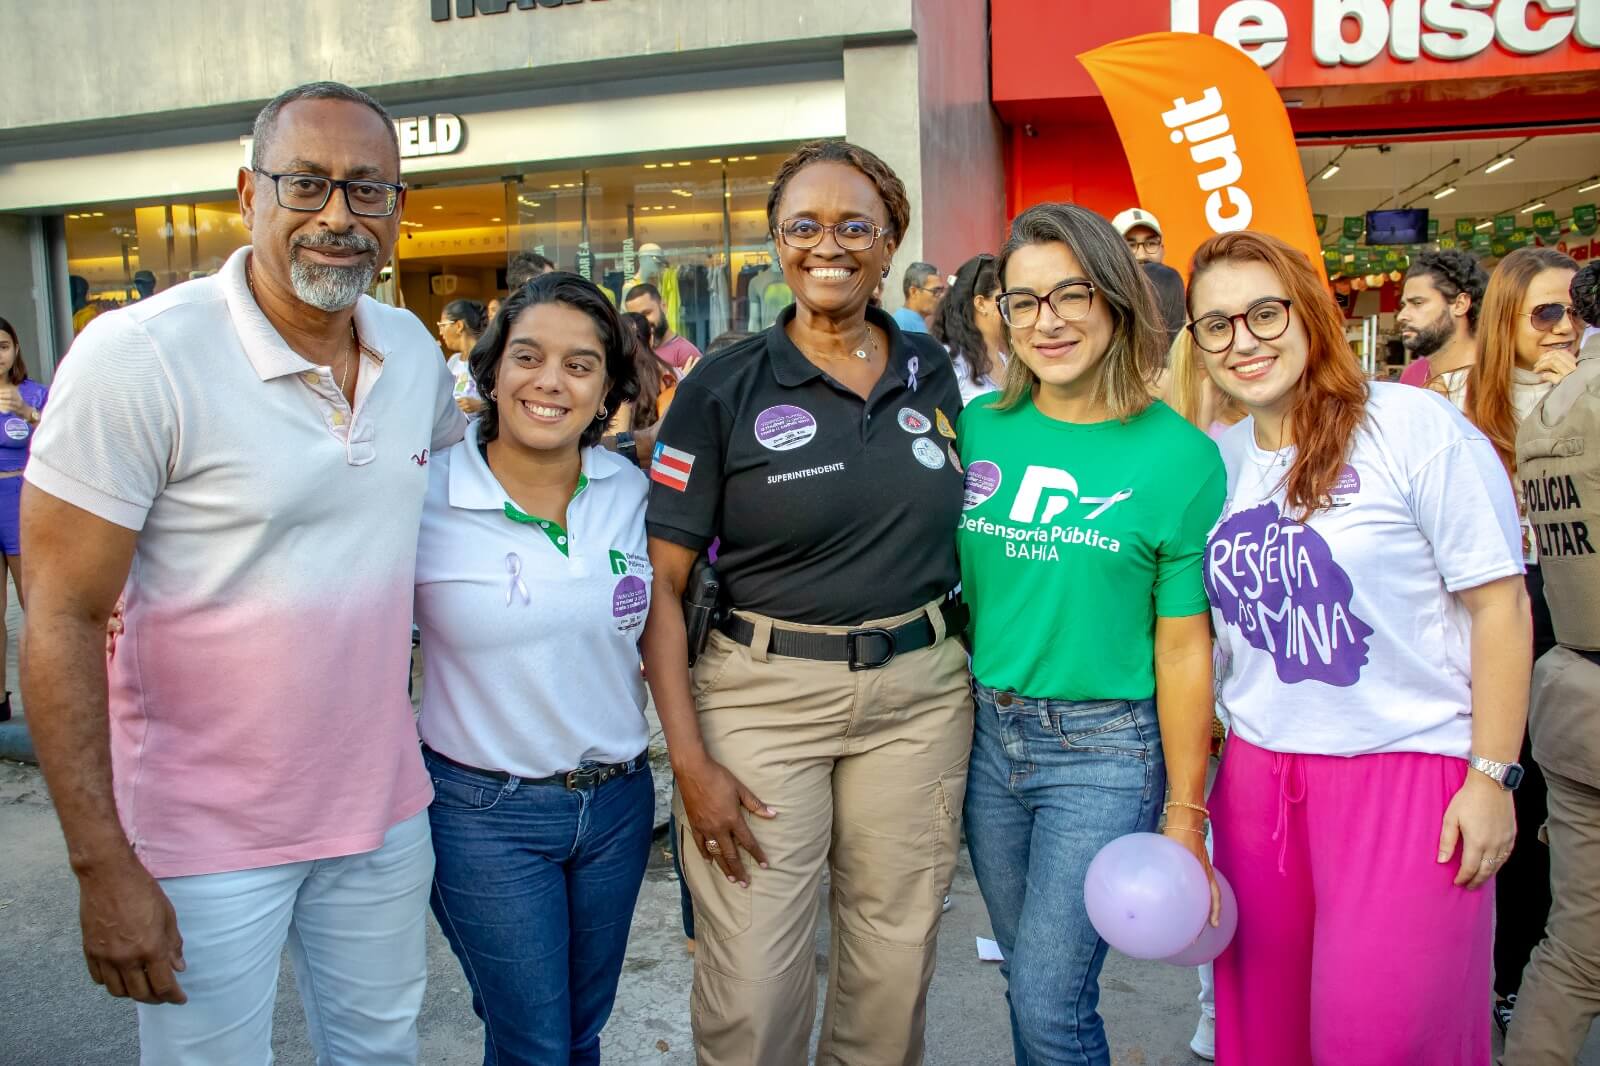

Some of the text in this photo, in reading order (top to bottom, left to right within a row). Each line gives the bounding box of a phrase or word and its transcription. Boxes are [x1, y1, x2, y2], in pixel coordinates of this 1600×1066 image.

[394, 112, 465, 159] ELD
[1161, 86, 1253, 234] cuit
[622, 238, 635, 280] VENTURA
[767, 462, 845, 484] SUPERINTENDENTE
[1521, 470, 1582, 512] POLÍCIA
[1050, 526, 1121, 553] Pública
[1535, 521, 1596, 556] LITAR
[1209, 523, 1319, 600] RESPEITA
[1238, 596, 1356, 666] AS MINA
